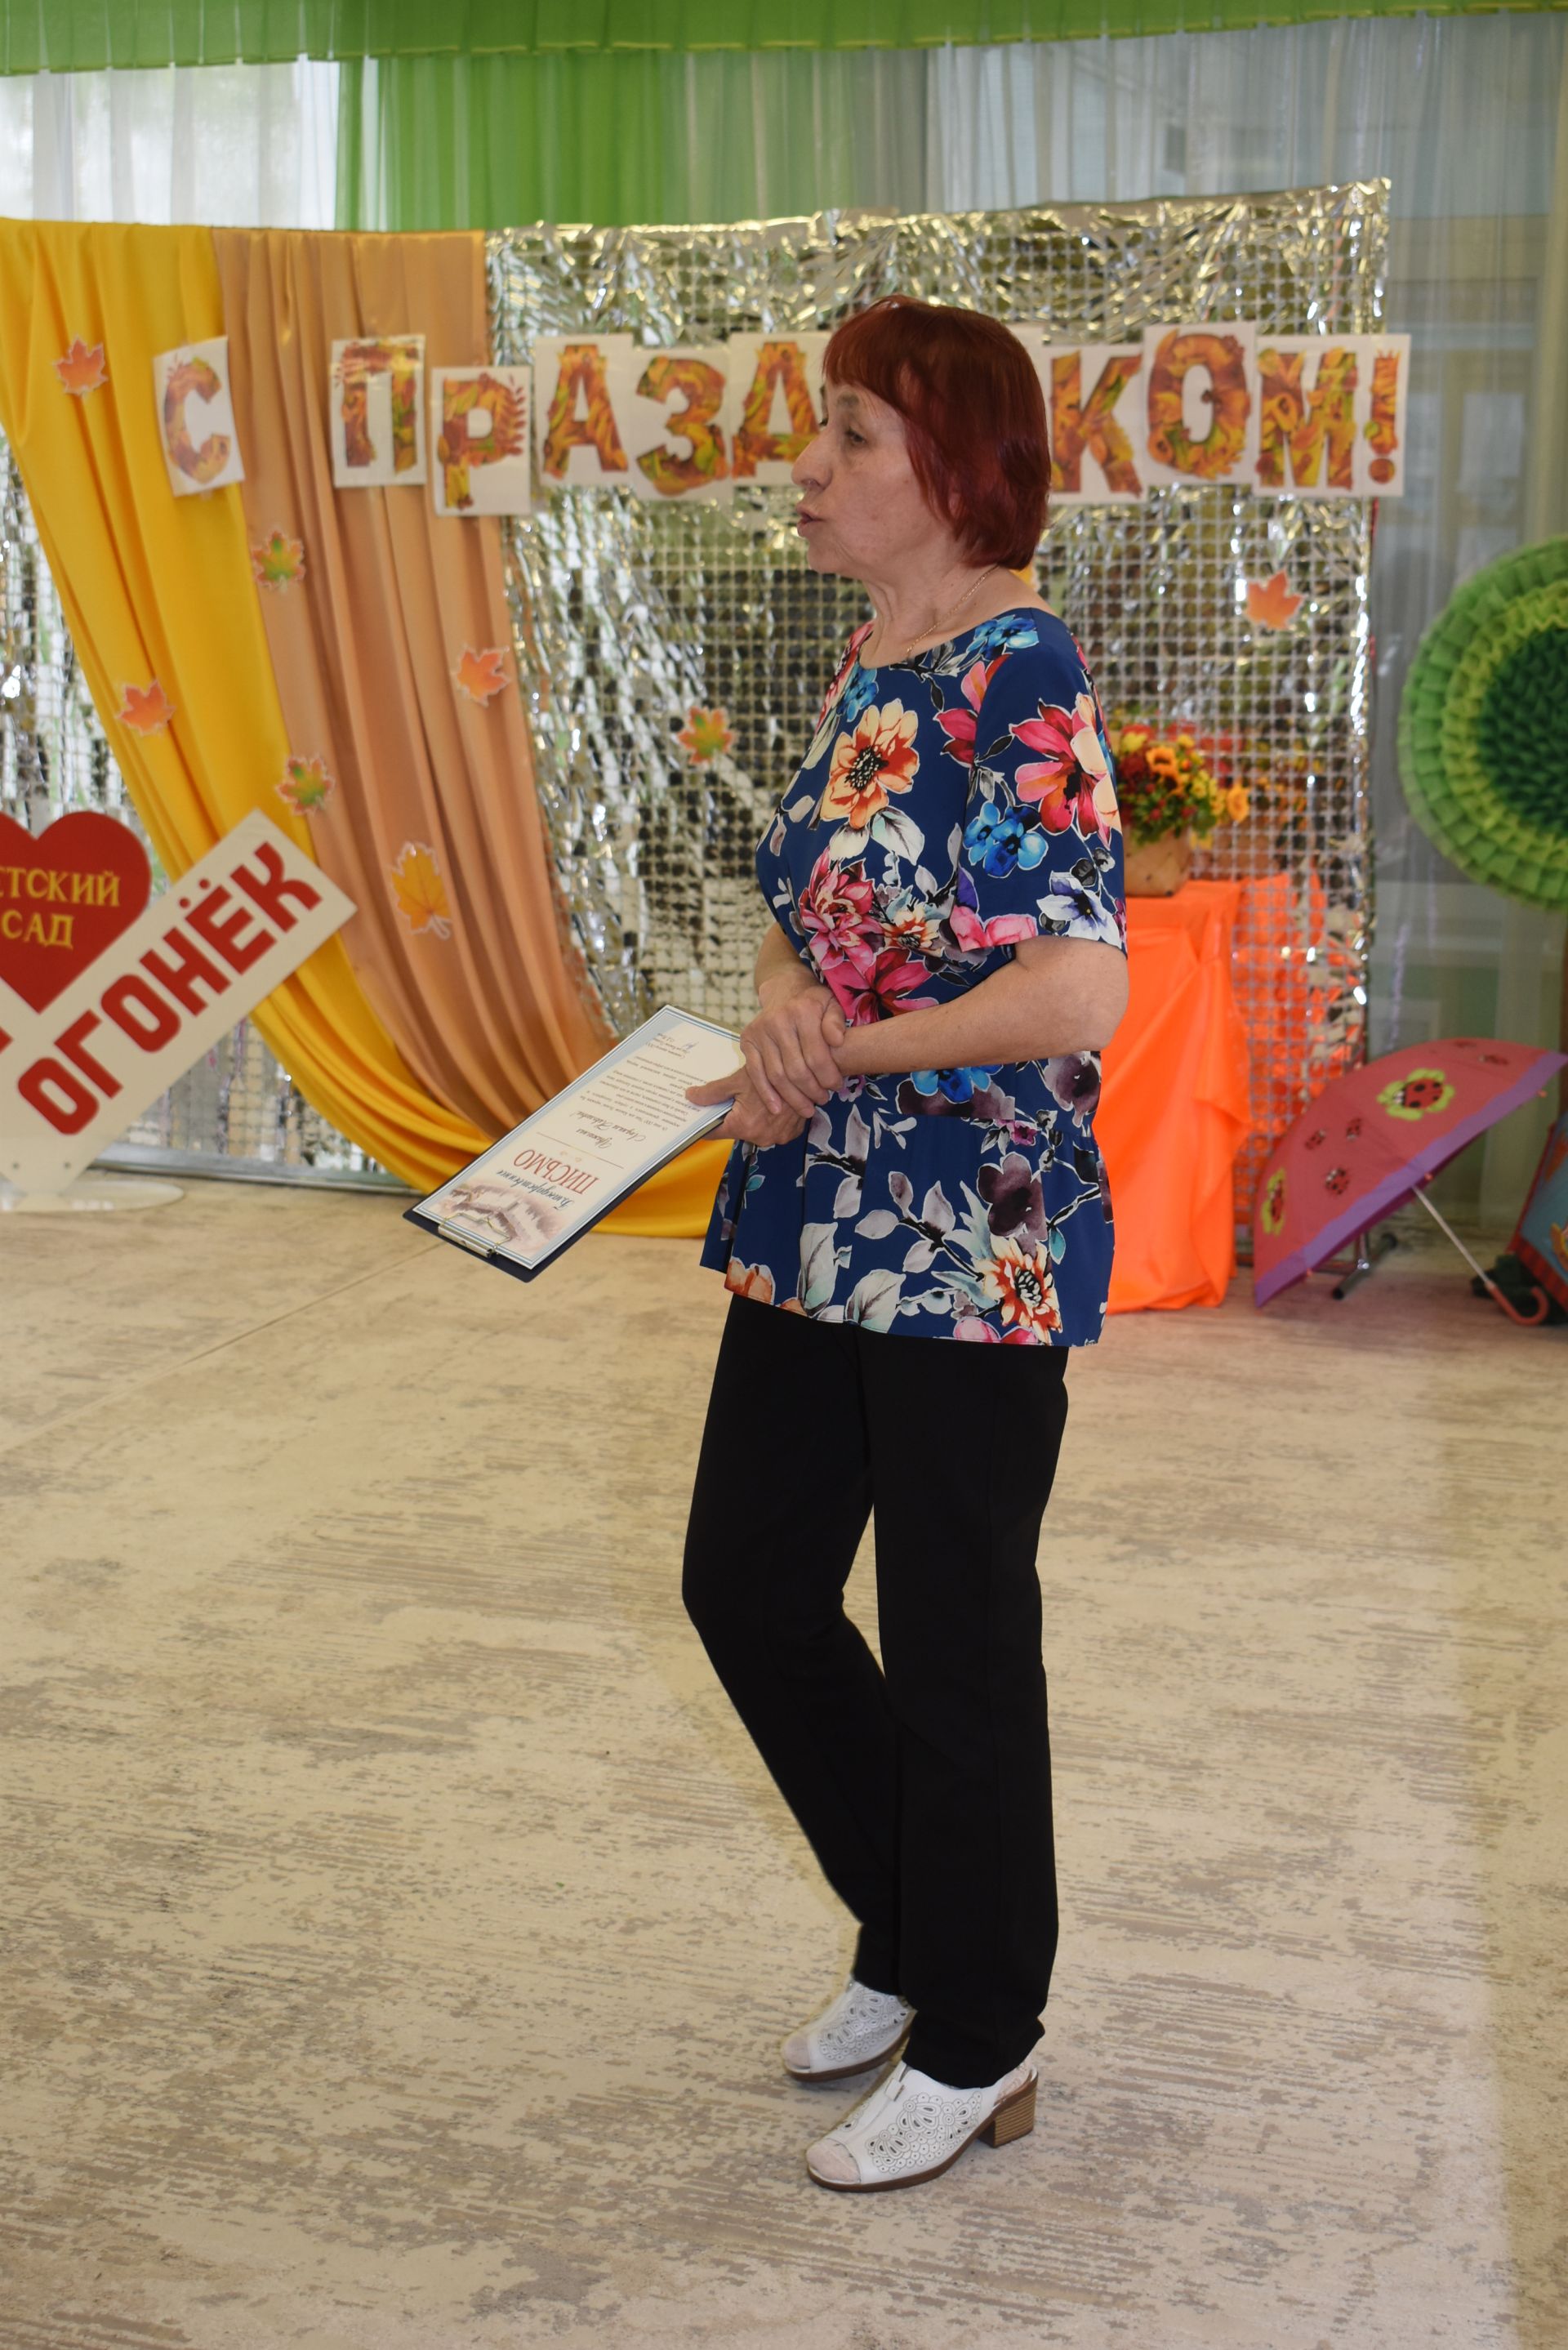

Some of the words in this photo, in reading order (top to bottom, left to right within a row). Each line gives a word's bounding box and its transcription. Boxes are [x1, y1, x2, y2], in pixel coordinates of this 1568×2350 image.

[163, 355, 230, 484] С
[332, 328, 1400, 510] ПРАЗДКОМ!
[2, 909, 74, 950] САД
[17, 841, 323, 1135] ОГОНЁК
[513, 1148, 599, 1194] ПИСЬМО
